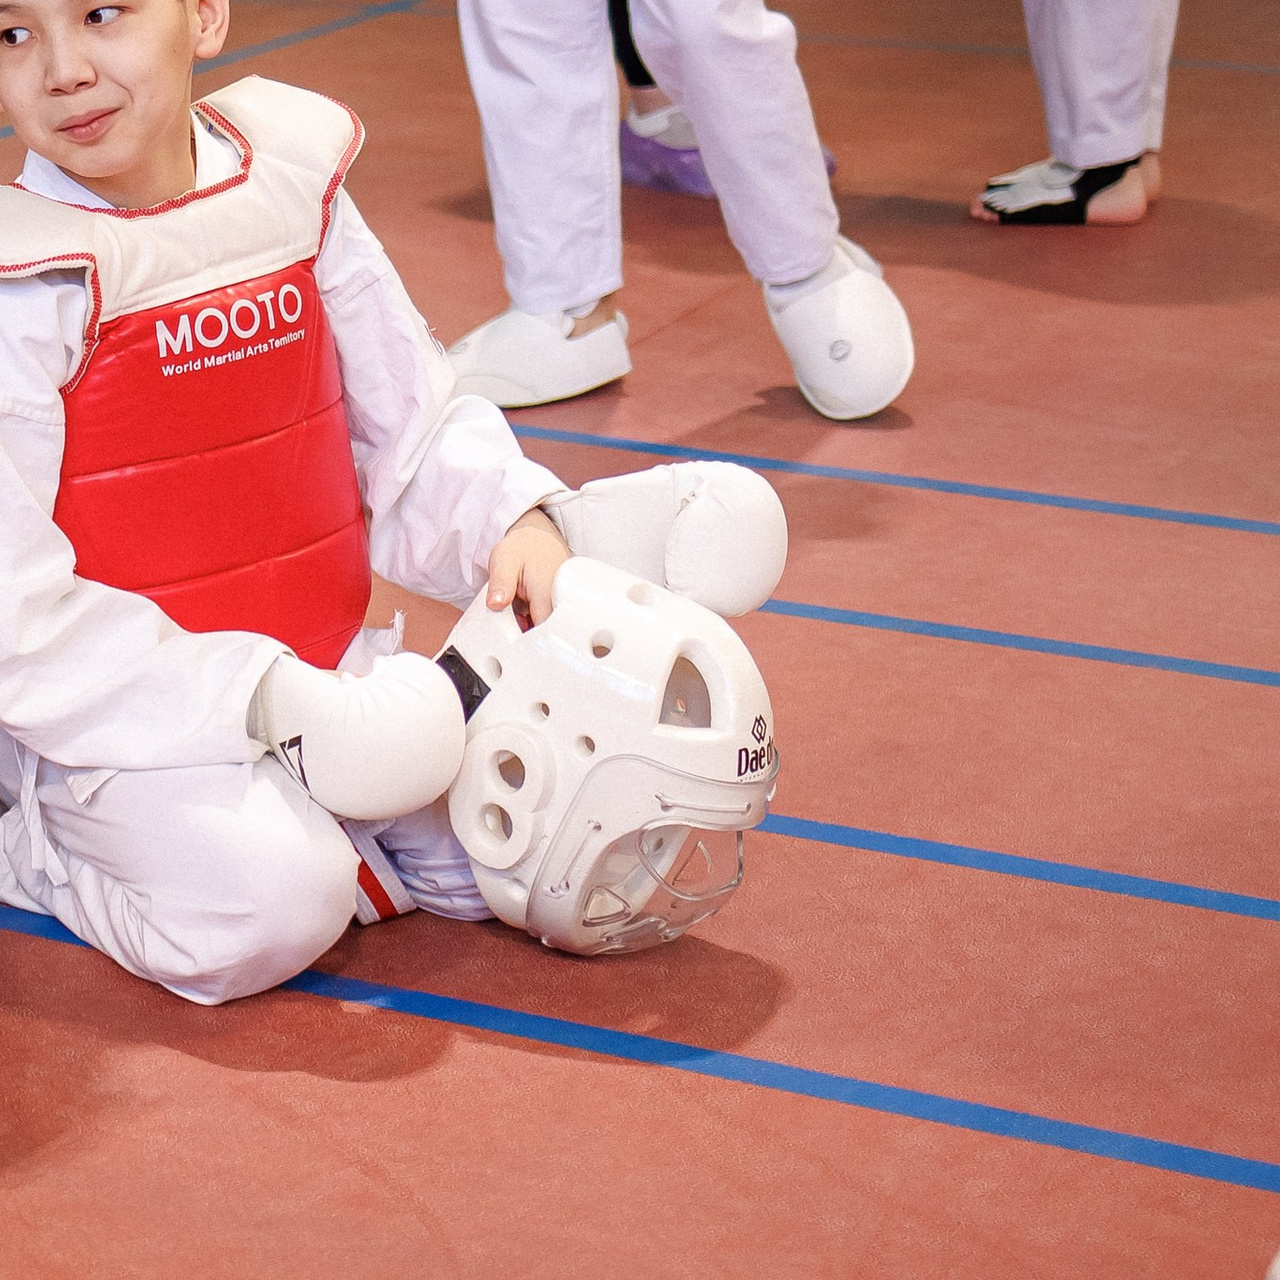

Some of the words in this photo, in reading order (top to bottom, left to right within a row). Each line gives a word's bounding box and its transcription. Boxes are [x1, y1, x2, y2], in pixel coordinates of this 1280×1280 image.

[155, 283, 303, 359] MOOTO
[161, 356, 202, 378] World
[204, 347, 246, 369] Martial
[246, 342, 269, 358] Arts
[737, 735, 775, 778] Daed
